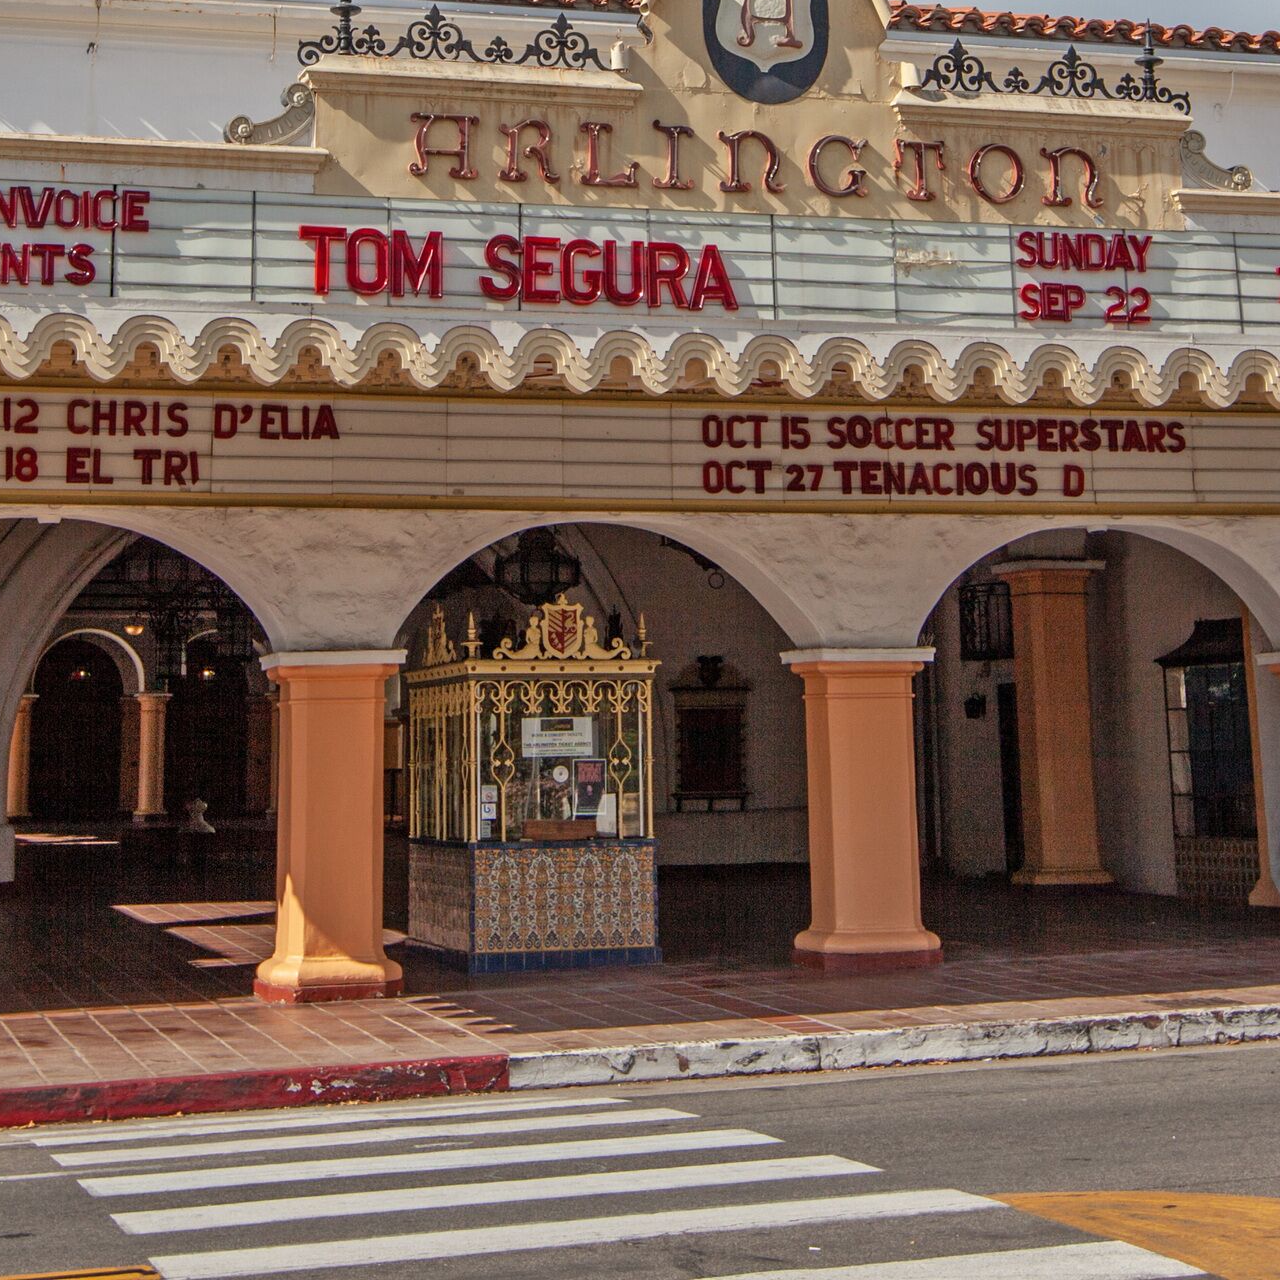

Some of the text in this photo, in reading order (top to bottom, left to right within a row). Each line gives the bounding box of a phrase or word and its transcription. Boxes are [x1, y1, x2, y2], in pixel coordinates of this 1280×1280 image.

[408, 112, 1105, 209] ARLINGTON
[298, 224, 739, 311] TOM SEGURA
[1016, 231, 1153, 273] SUNDAY
[1020, 282, 1152, 324] SEP 22
[2, 397, 40, 434] 12
[67, 399, 188, 438] CHRIS
[214, 403, 340, 440] D'ELIA
[702, 414, 1187, 454] OCT 15 SOCCER SUPERSTARS
[4, 446, 39, 482] 18
[66, 447, 114, 485] EL
[132, 448, 200, 486] TRI
[703, 459, 1086, 498] OCT 27 TENACIOUS D
